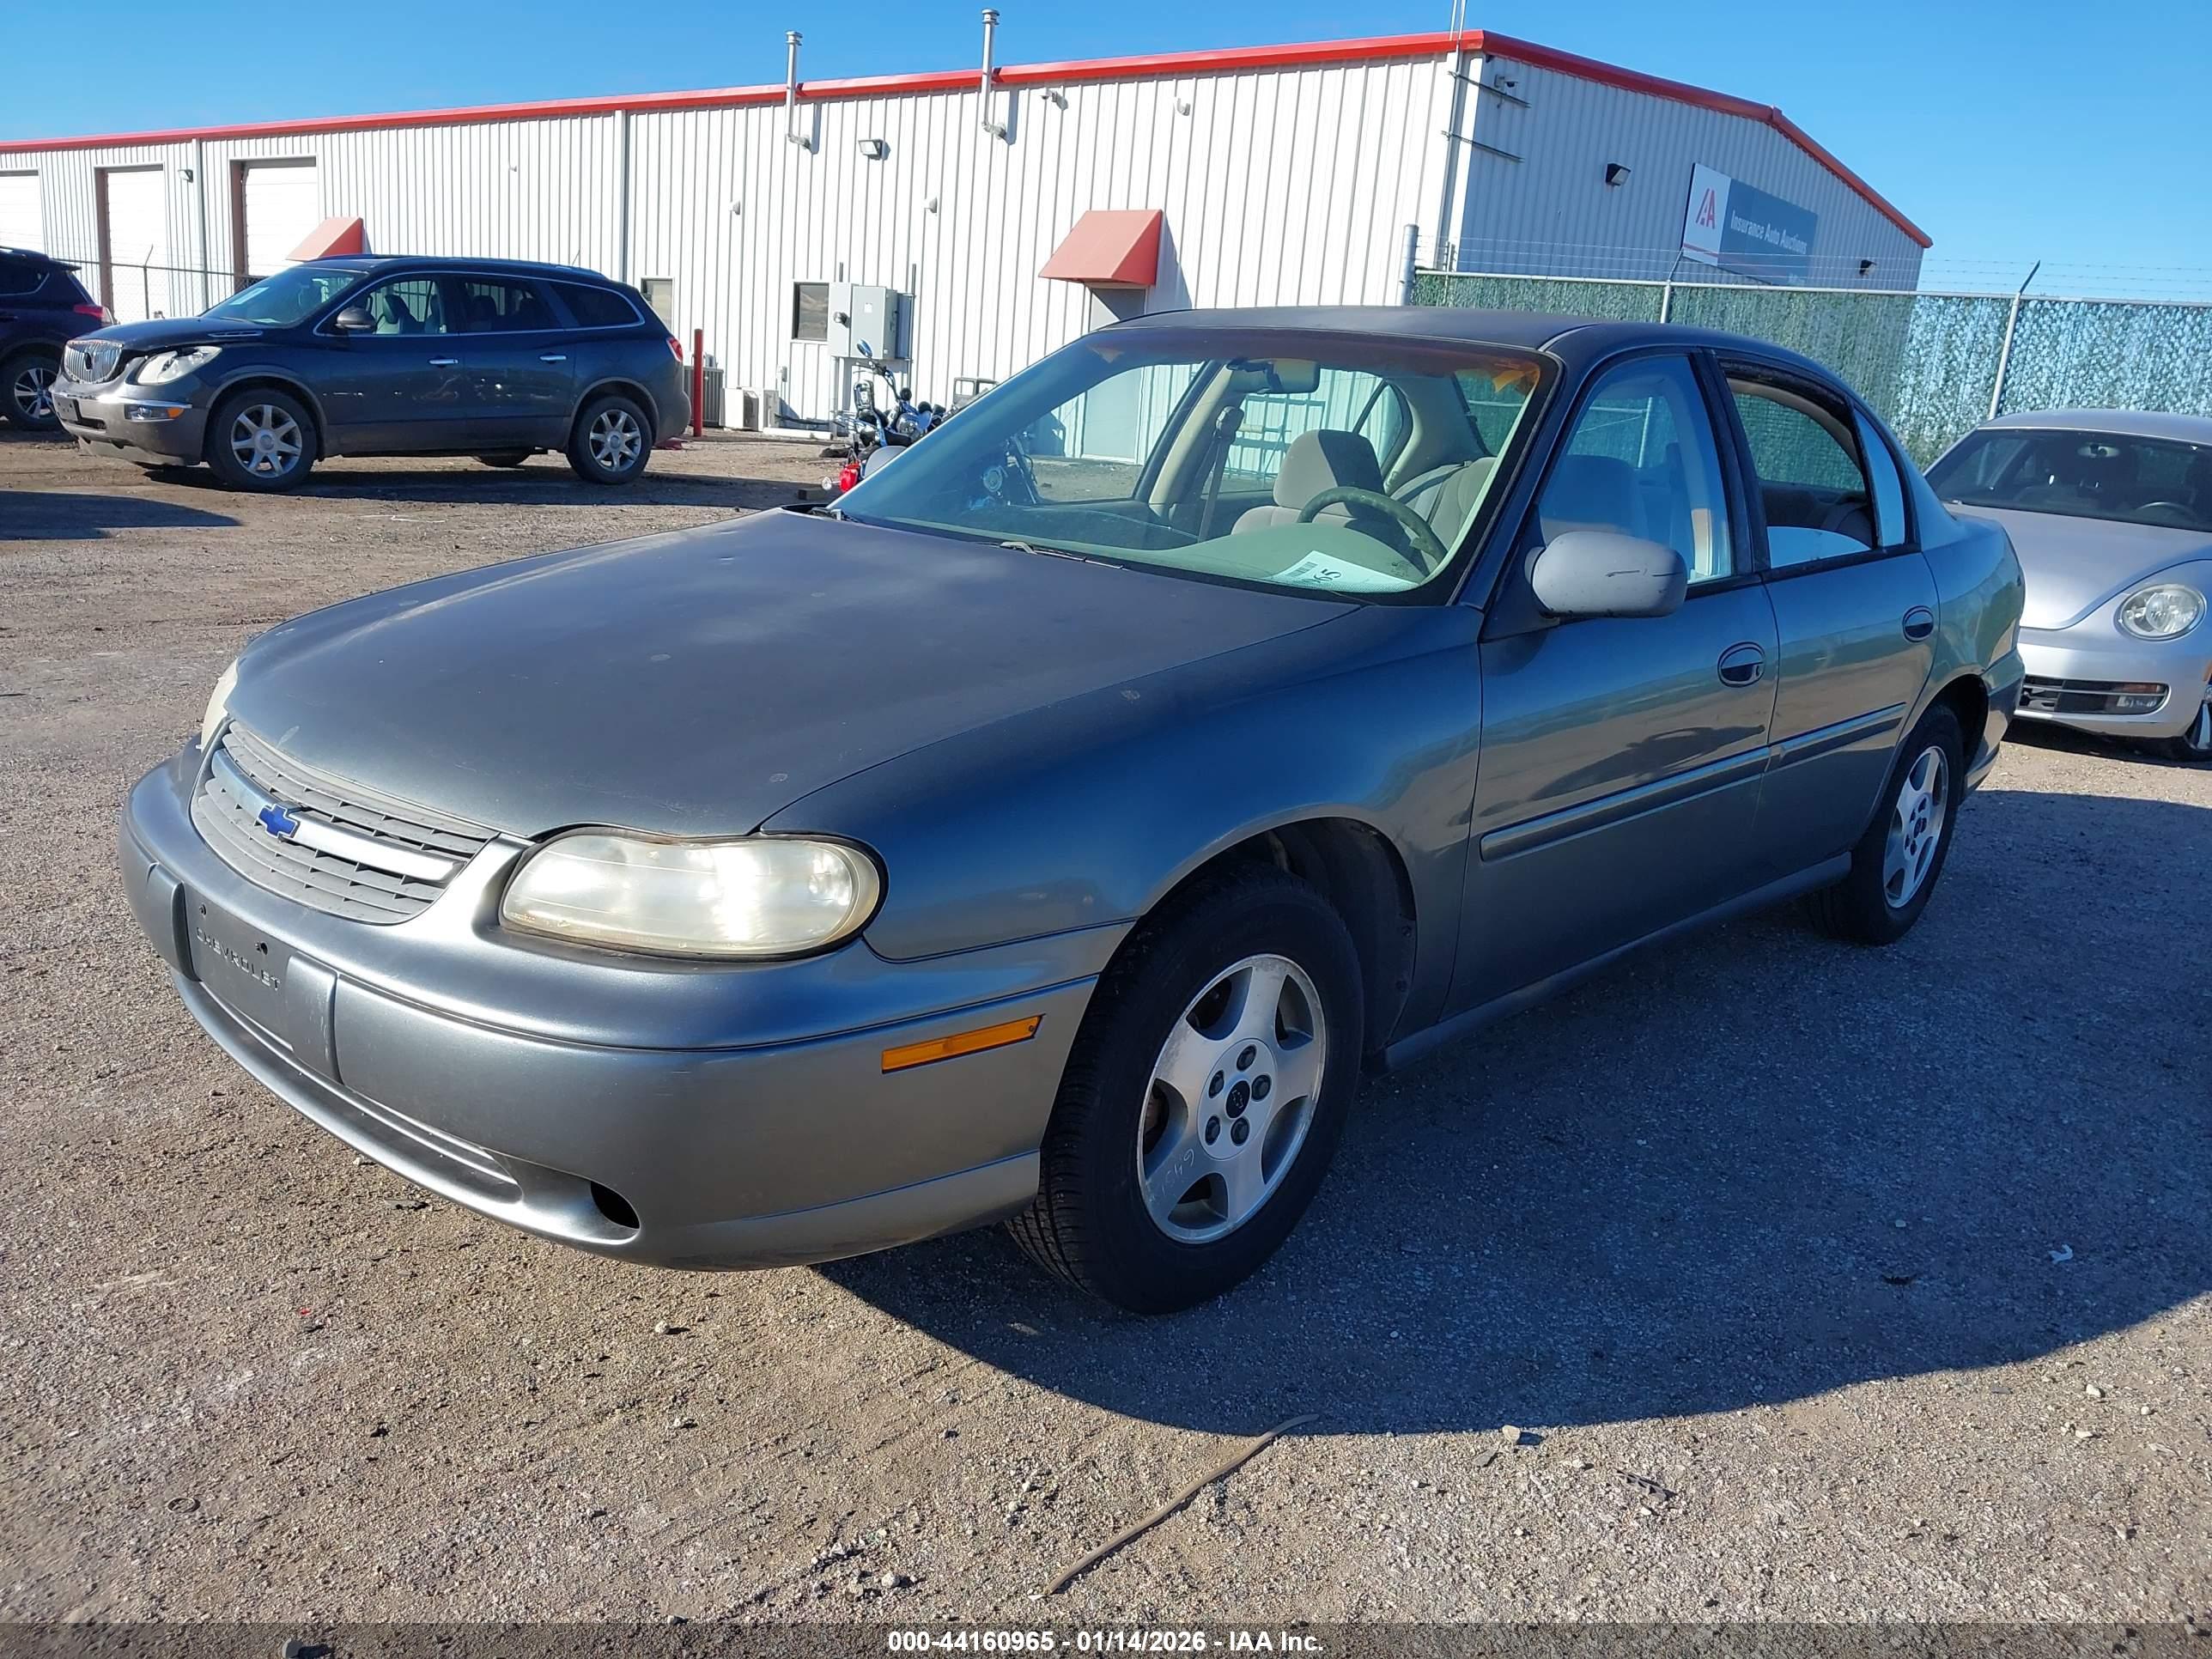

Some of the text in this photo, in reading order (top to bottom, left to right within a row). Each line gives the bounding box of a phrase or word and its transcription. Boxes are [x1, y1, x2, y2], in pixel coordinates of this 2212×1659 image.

[1730, 209, 1808, 254] Insurance Auto Auctions
[196, 927, 281, 991] CHEVROLET
